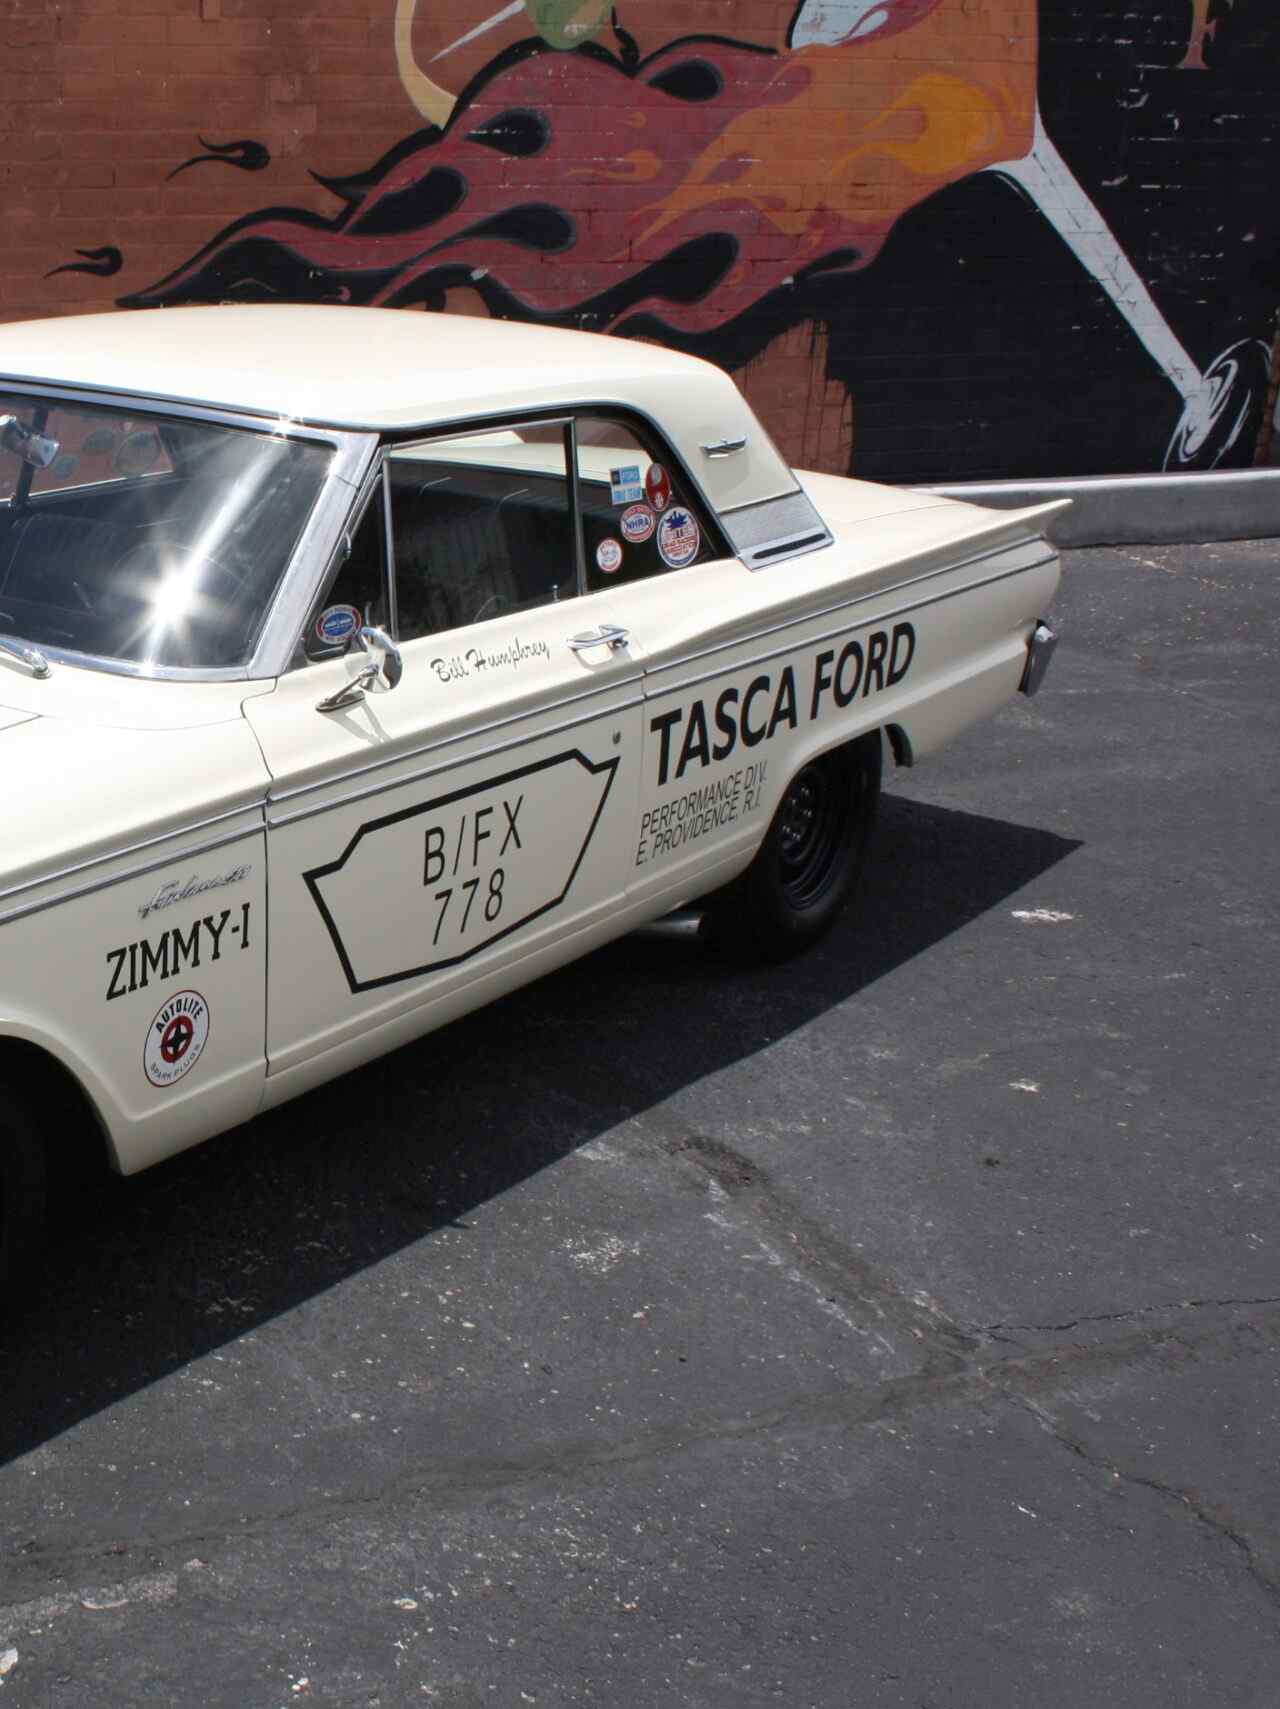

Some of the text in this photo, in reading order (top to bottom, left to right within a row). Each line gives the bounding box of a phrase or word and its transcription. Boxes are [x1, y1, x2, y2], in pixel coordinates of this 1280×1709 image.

[626, 516, 650, 529] NHRA
[430, 655, 470, 683] Bill
[650, 622, 915, 787] TASCA FORD
[640, 761, 767, 839] PERFORMANCE DIV.
[423, 794, 523, 887] B/FX
[635, 840, 648, 867] E.
[432, 867, 505, 946] 778
[156, 998, 203, 1034] AUTOLITE
